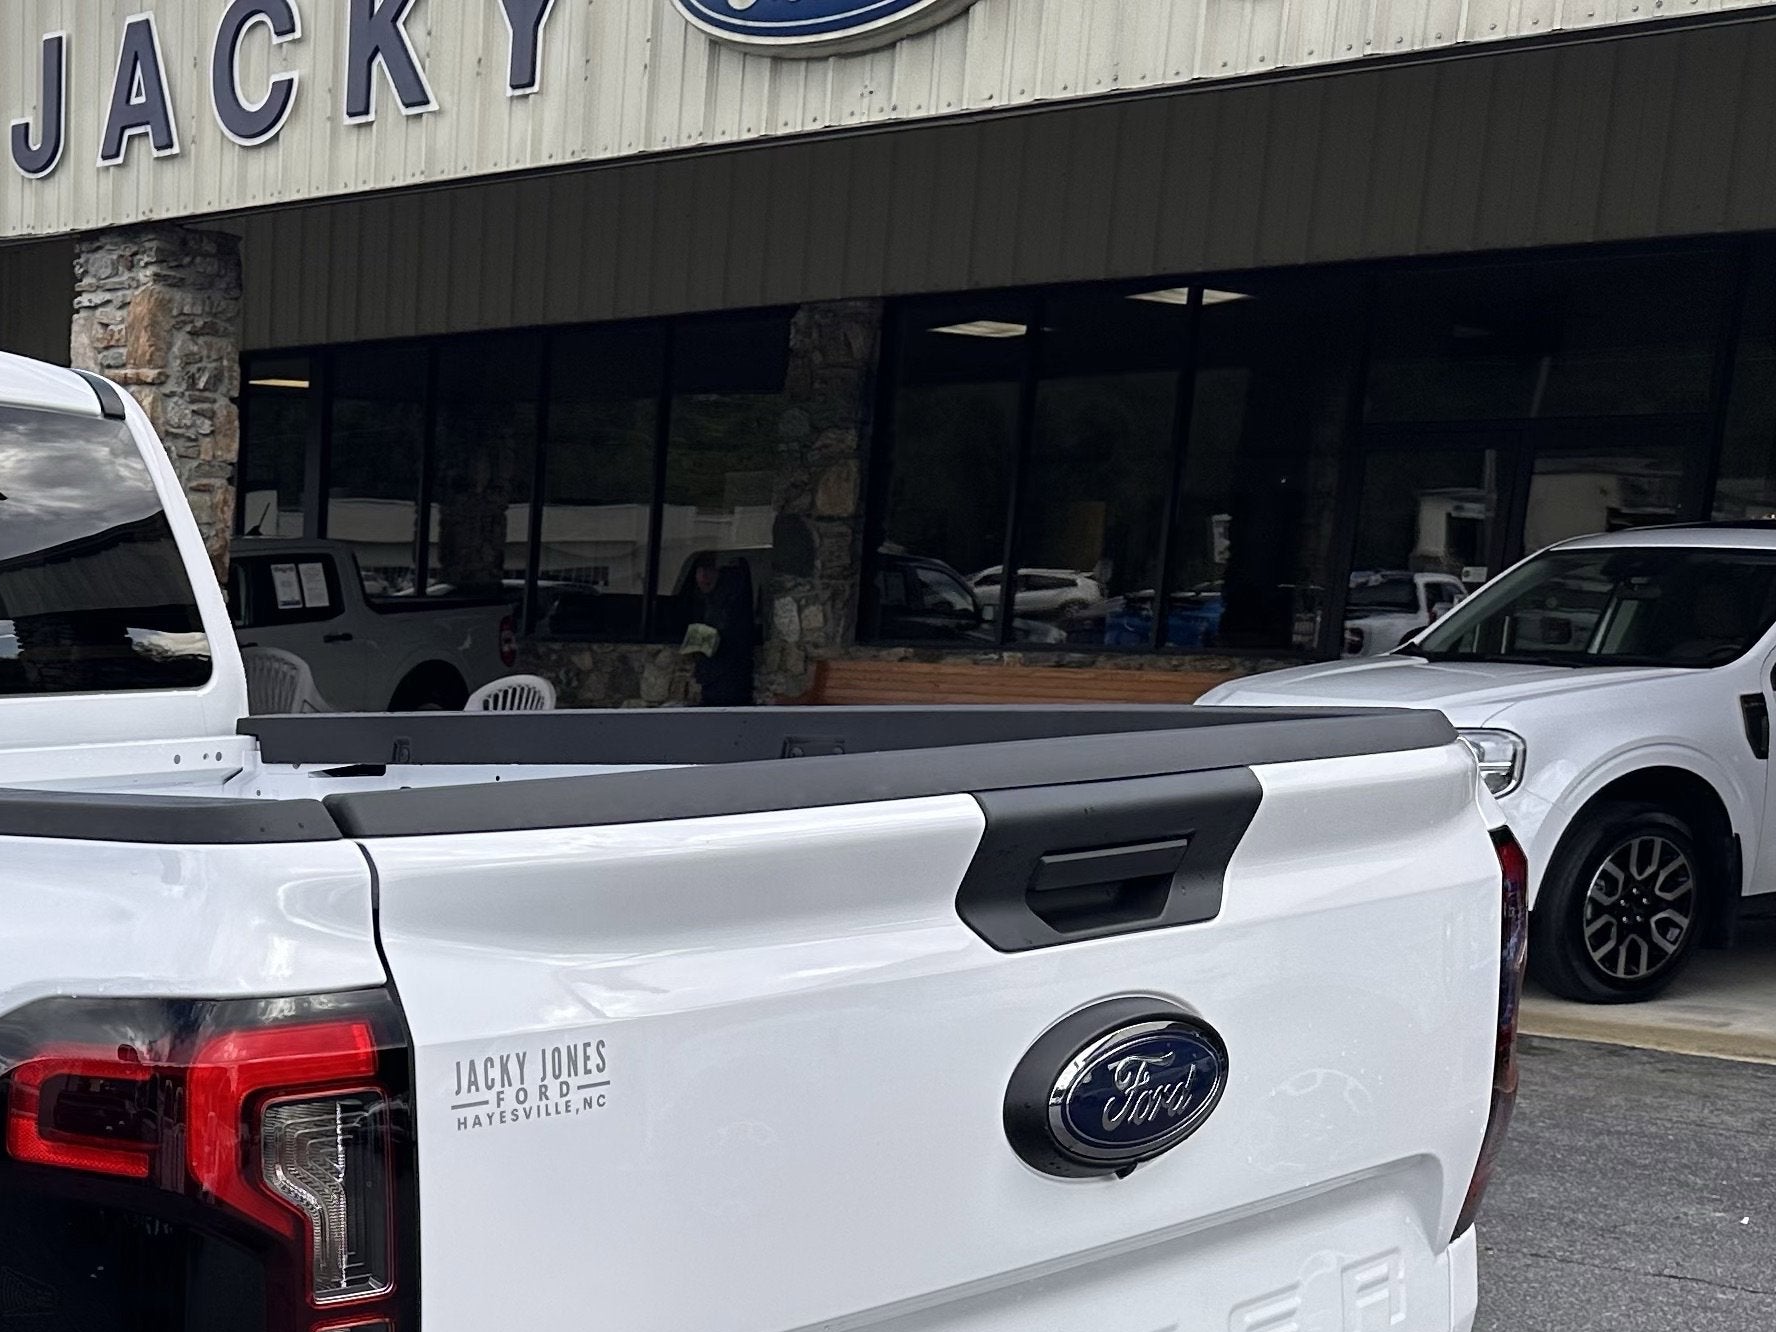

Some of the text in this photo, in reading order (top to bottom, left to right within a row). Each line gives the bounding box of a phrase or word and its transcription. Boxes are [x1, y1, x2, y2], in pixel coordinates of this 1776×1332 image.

[10, 0, 555, 179] JACKY
[455, 1039, 606, 1096] JACKY JONES
[496, 1080, 570, 1108] FORD
[1101, 1051, 1197, 1131] Ford
